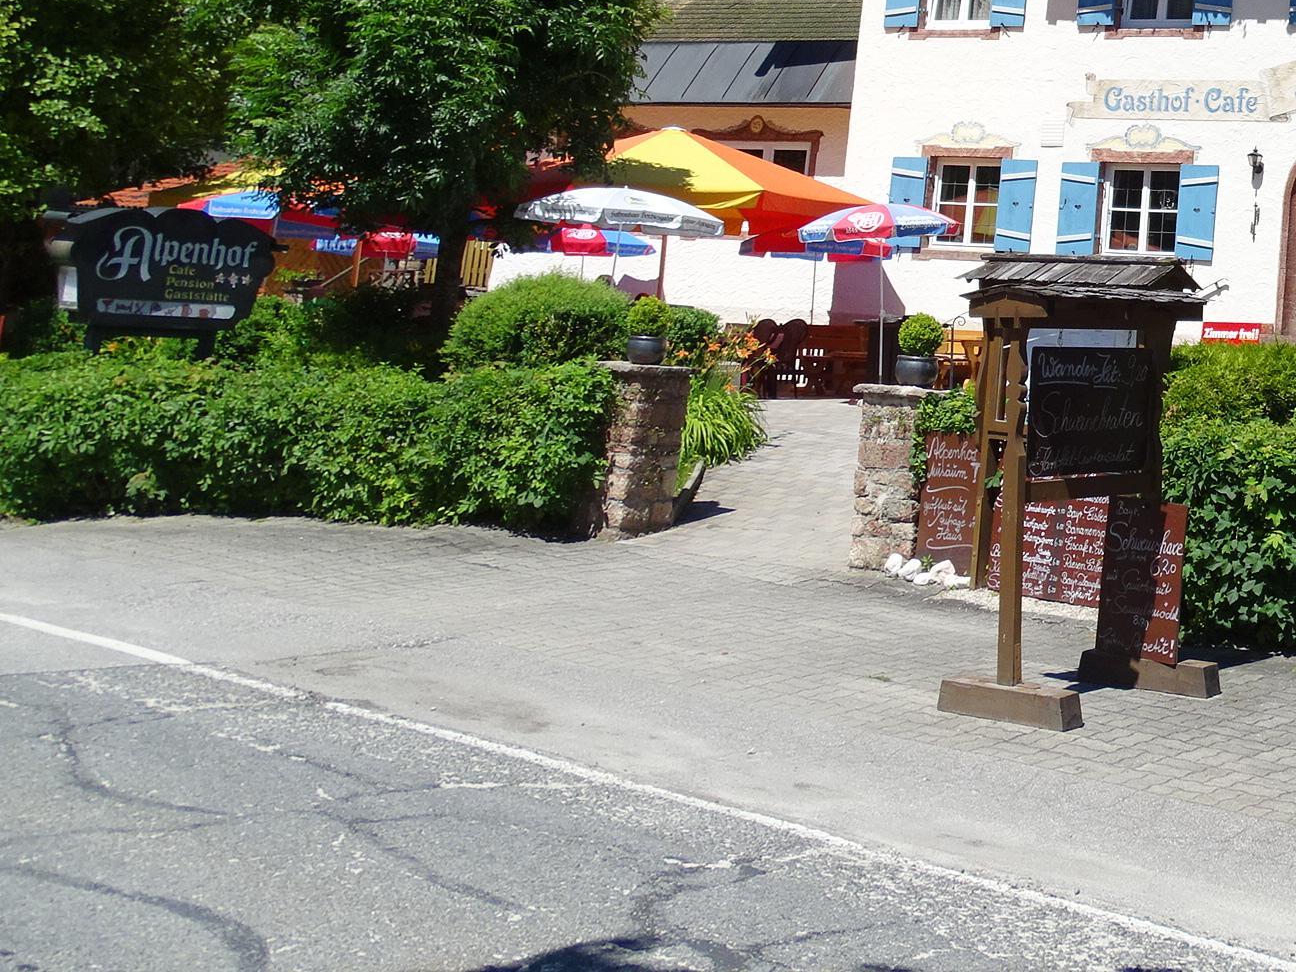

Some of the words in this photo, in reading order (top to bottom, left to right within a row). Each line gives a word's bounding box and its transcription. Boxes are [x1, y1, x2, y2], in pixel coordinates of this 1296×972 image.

[1103, 86, 1194, 113] Gasthof
[1203, 87, 1258, 114] Cafe
[96, 225, 258, 283] Alpenhof
[168, 264, 196, 276] Cafe
[166, 277, 215, 289] Pension
[1203, 327, 1239, 339] Zimmer
[1239, 328, 1260, 340] frei!
